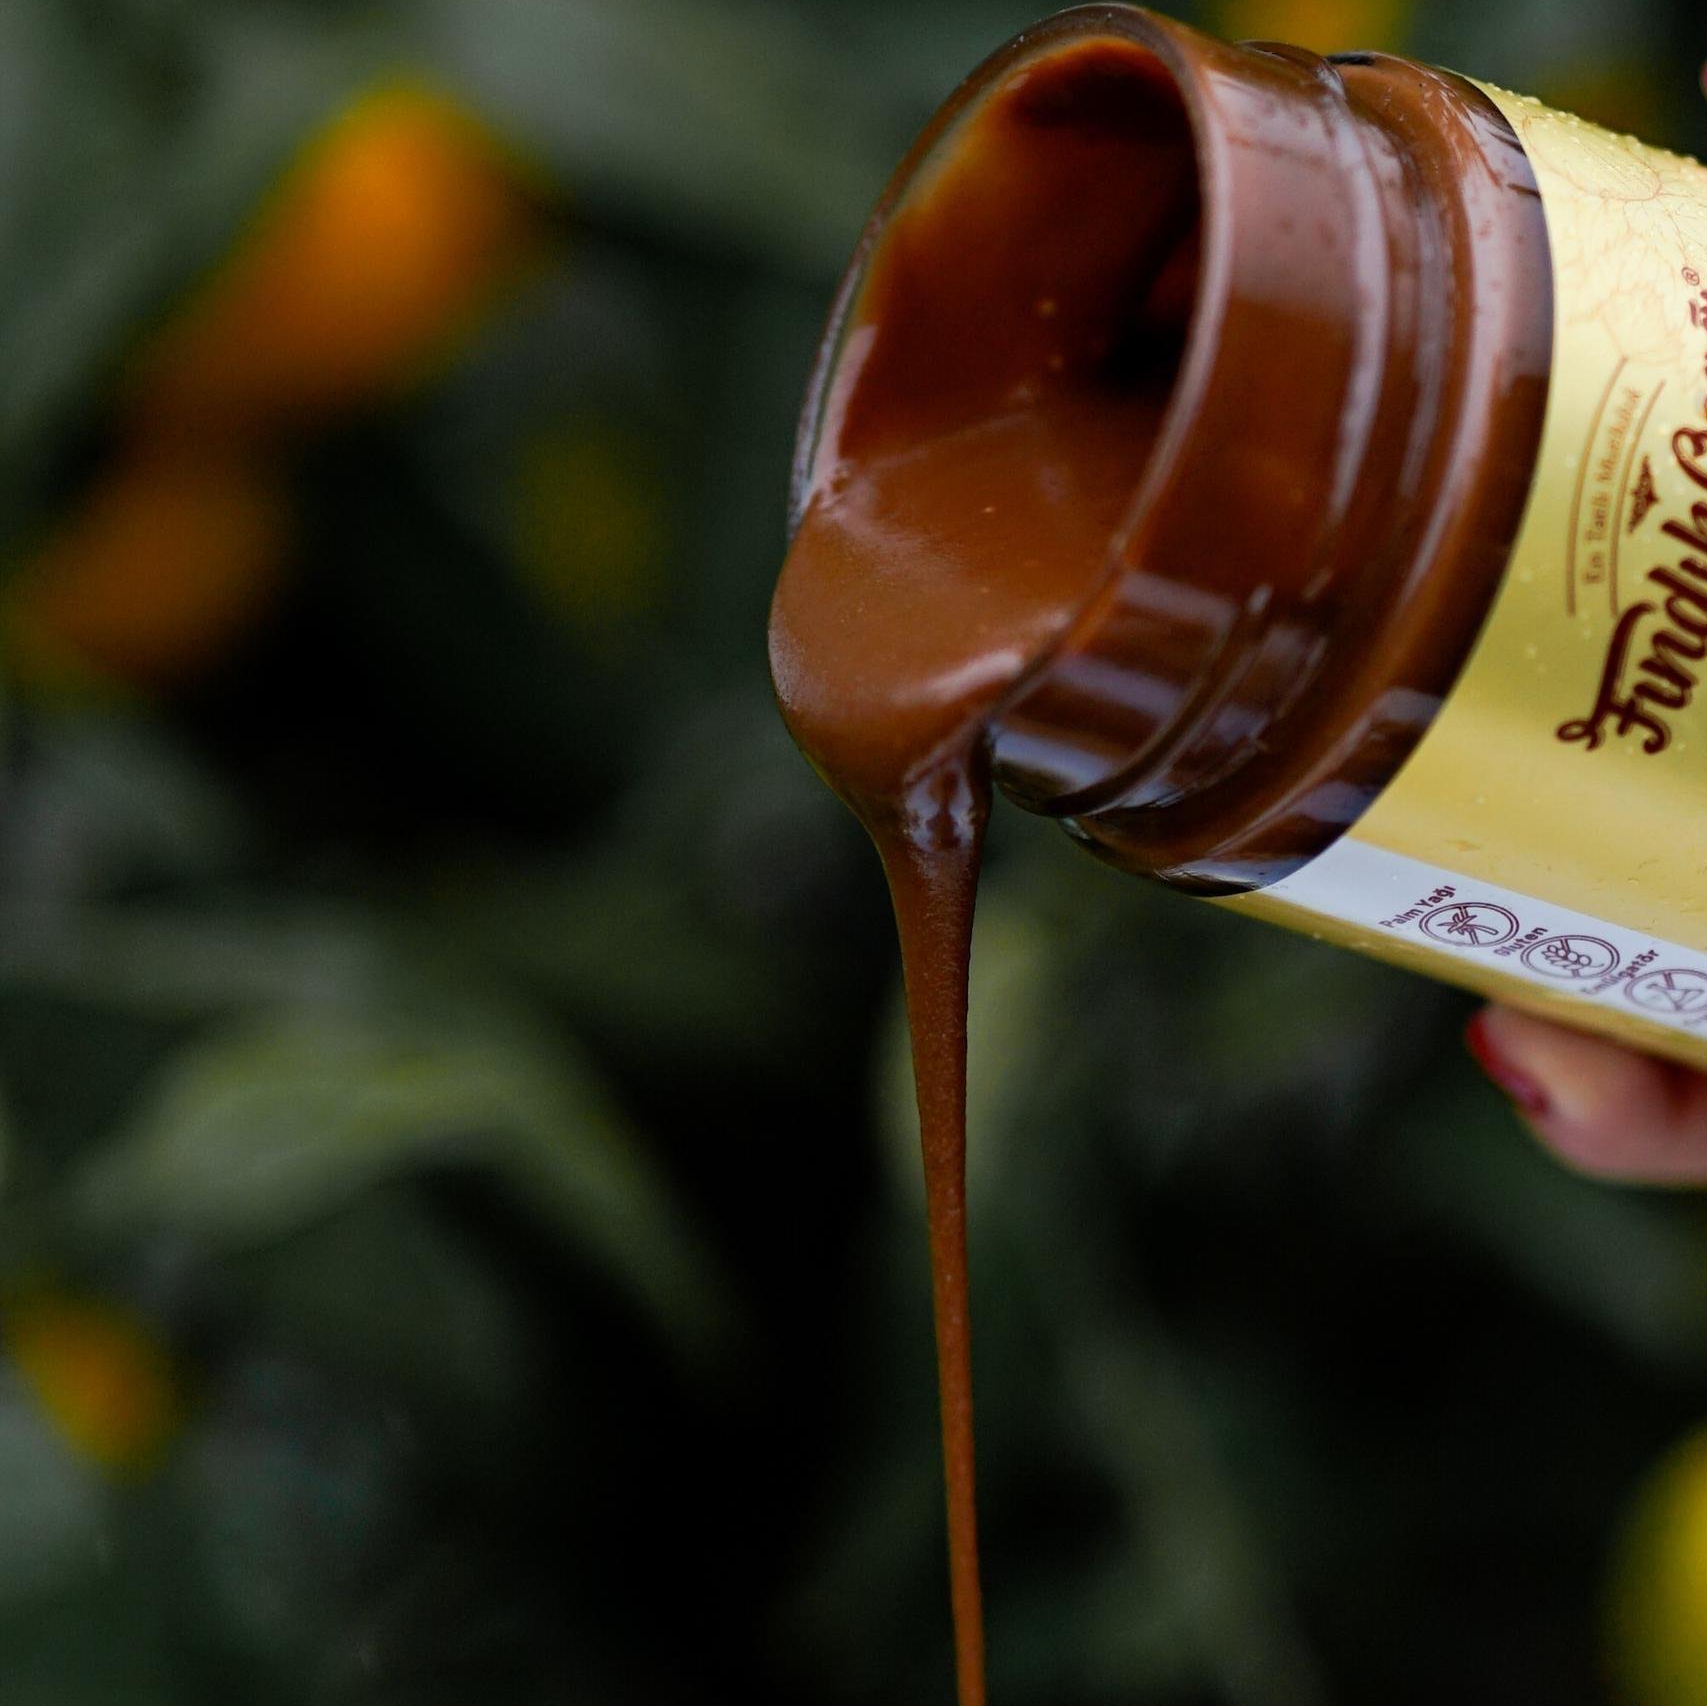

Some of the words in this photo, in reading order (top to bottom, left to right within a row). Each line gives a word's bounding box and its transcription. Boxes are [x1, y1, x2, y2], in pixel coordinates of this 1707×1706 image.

[1379, 906, 1424, 929] Palm
[1414, 885, 1457, 908] Yağı
[1493, 926, 1549, 957] Gluten
